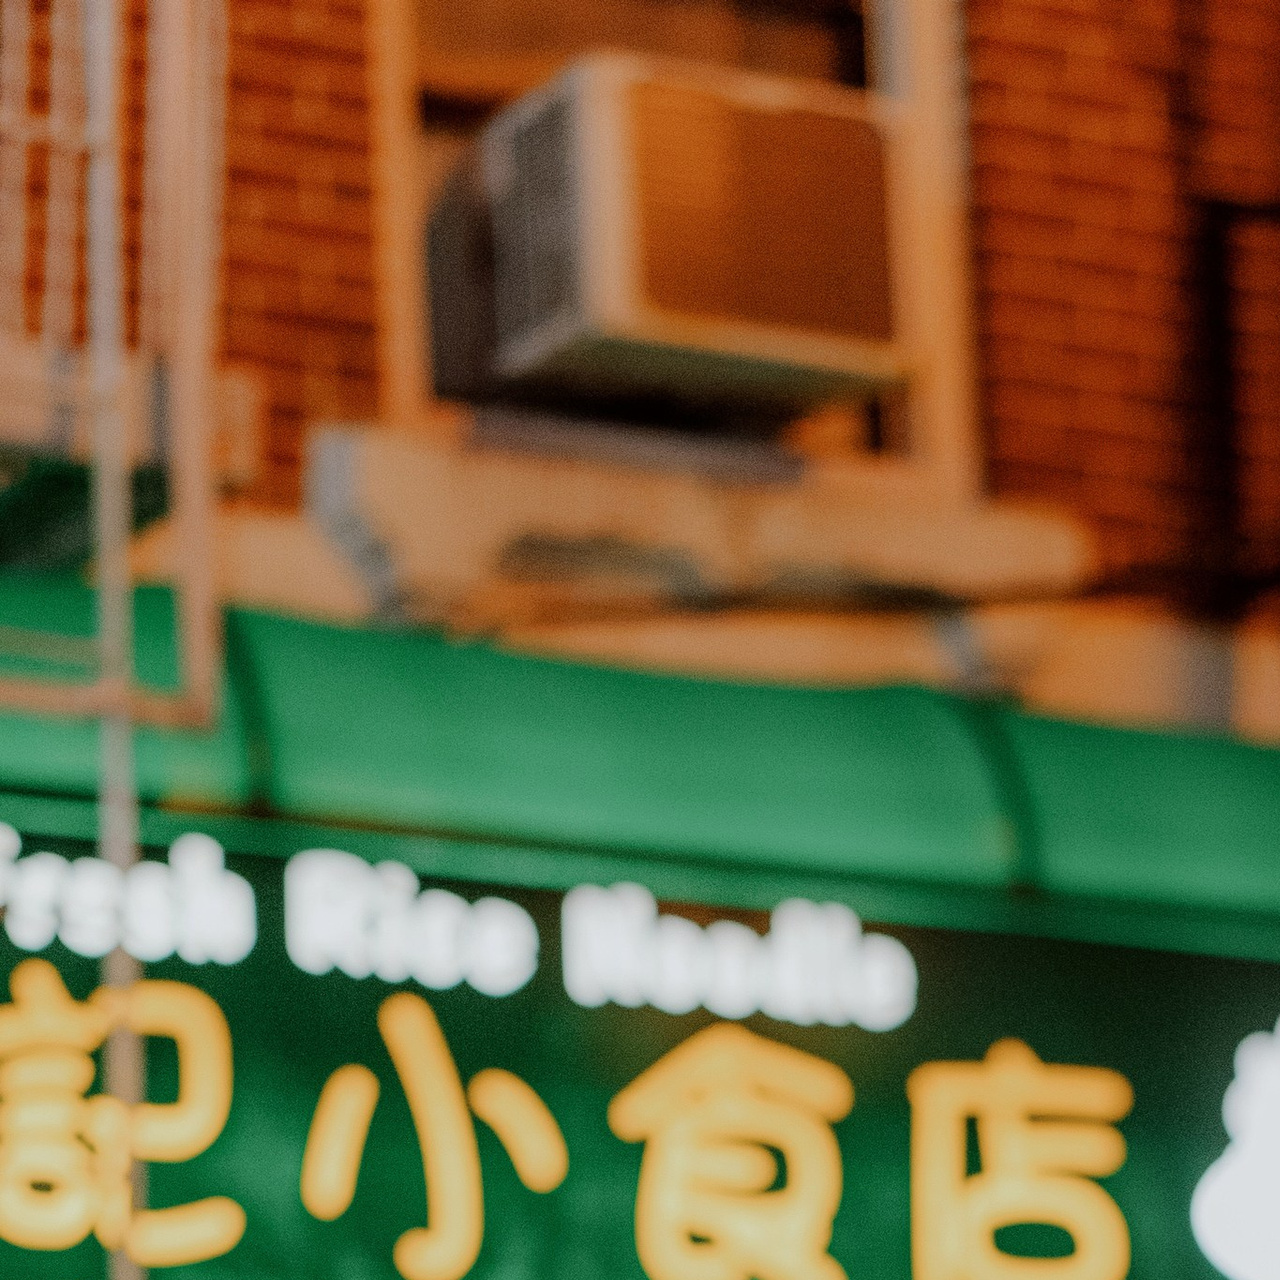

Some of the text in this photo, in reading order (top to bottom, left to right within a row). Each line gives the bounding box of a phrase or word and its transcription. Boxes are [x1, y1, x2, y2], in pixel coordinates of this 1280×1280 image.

[0, 822, 919, 1034] resh Rice Noodle
